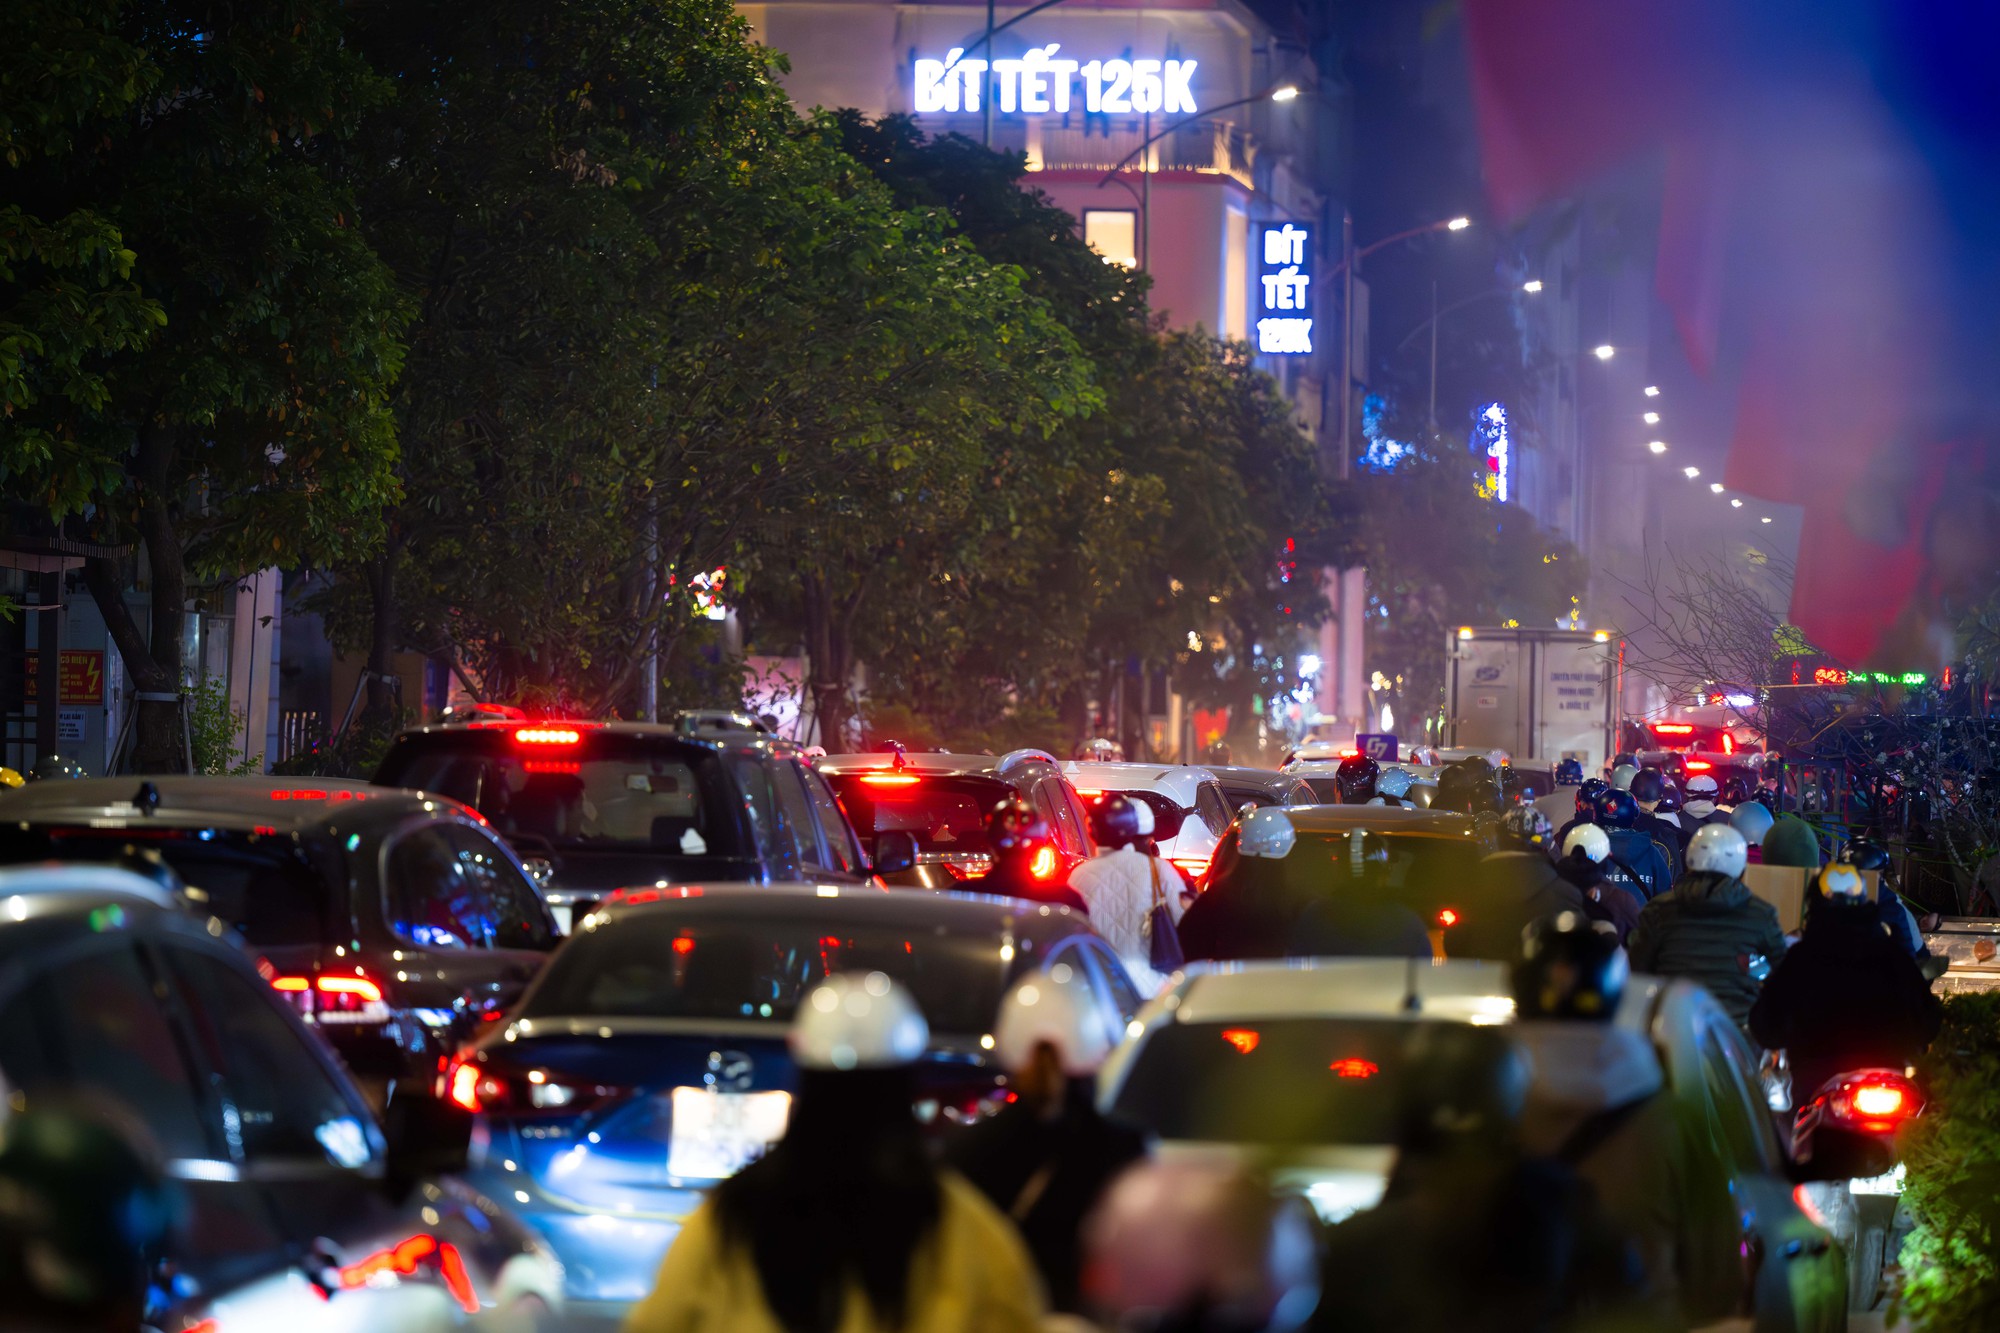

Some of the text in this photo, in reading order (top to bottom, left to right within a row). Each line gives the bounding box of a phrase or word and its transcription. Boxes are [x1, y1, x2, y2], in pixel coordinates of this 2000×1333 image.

[915, 44, 1198, 113] BÍT TẾT 125K
[1265, 223, 1307, 264] BÍT
[1261, 265, 1309, 309] TẾT
